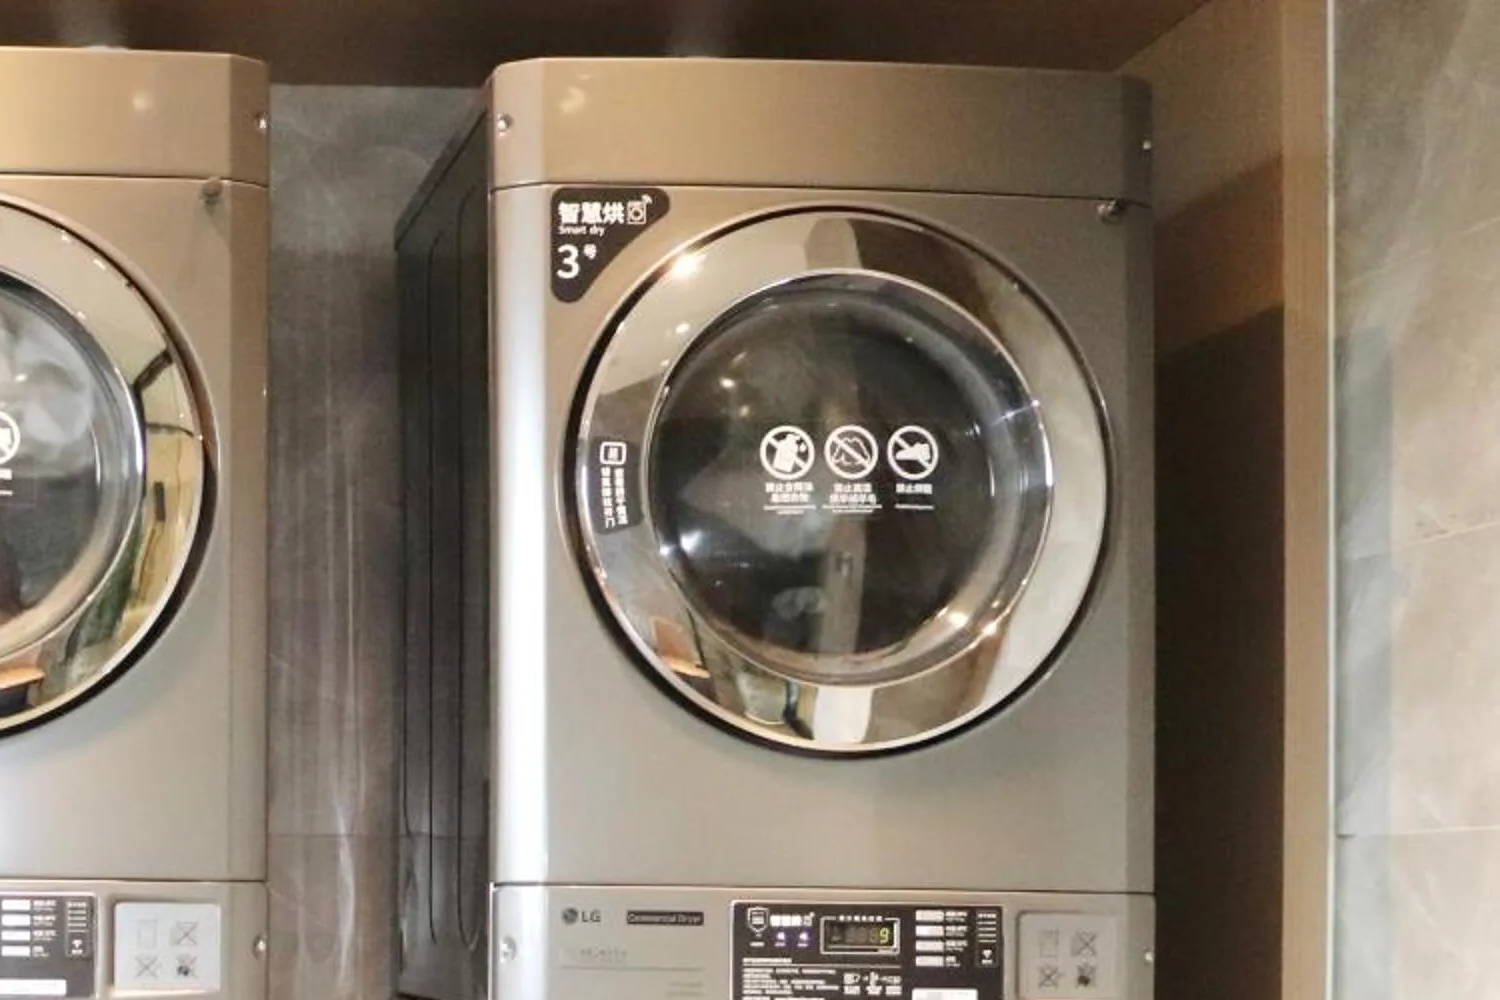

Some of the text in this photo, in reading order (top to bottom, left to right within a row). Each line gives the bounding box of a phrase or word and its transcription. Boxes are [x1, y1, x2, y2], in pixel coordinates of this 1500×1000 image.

[559, 202, 624, 223] 智慧烘
[581, 910, 601, 923] LG
